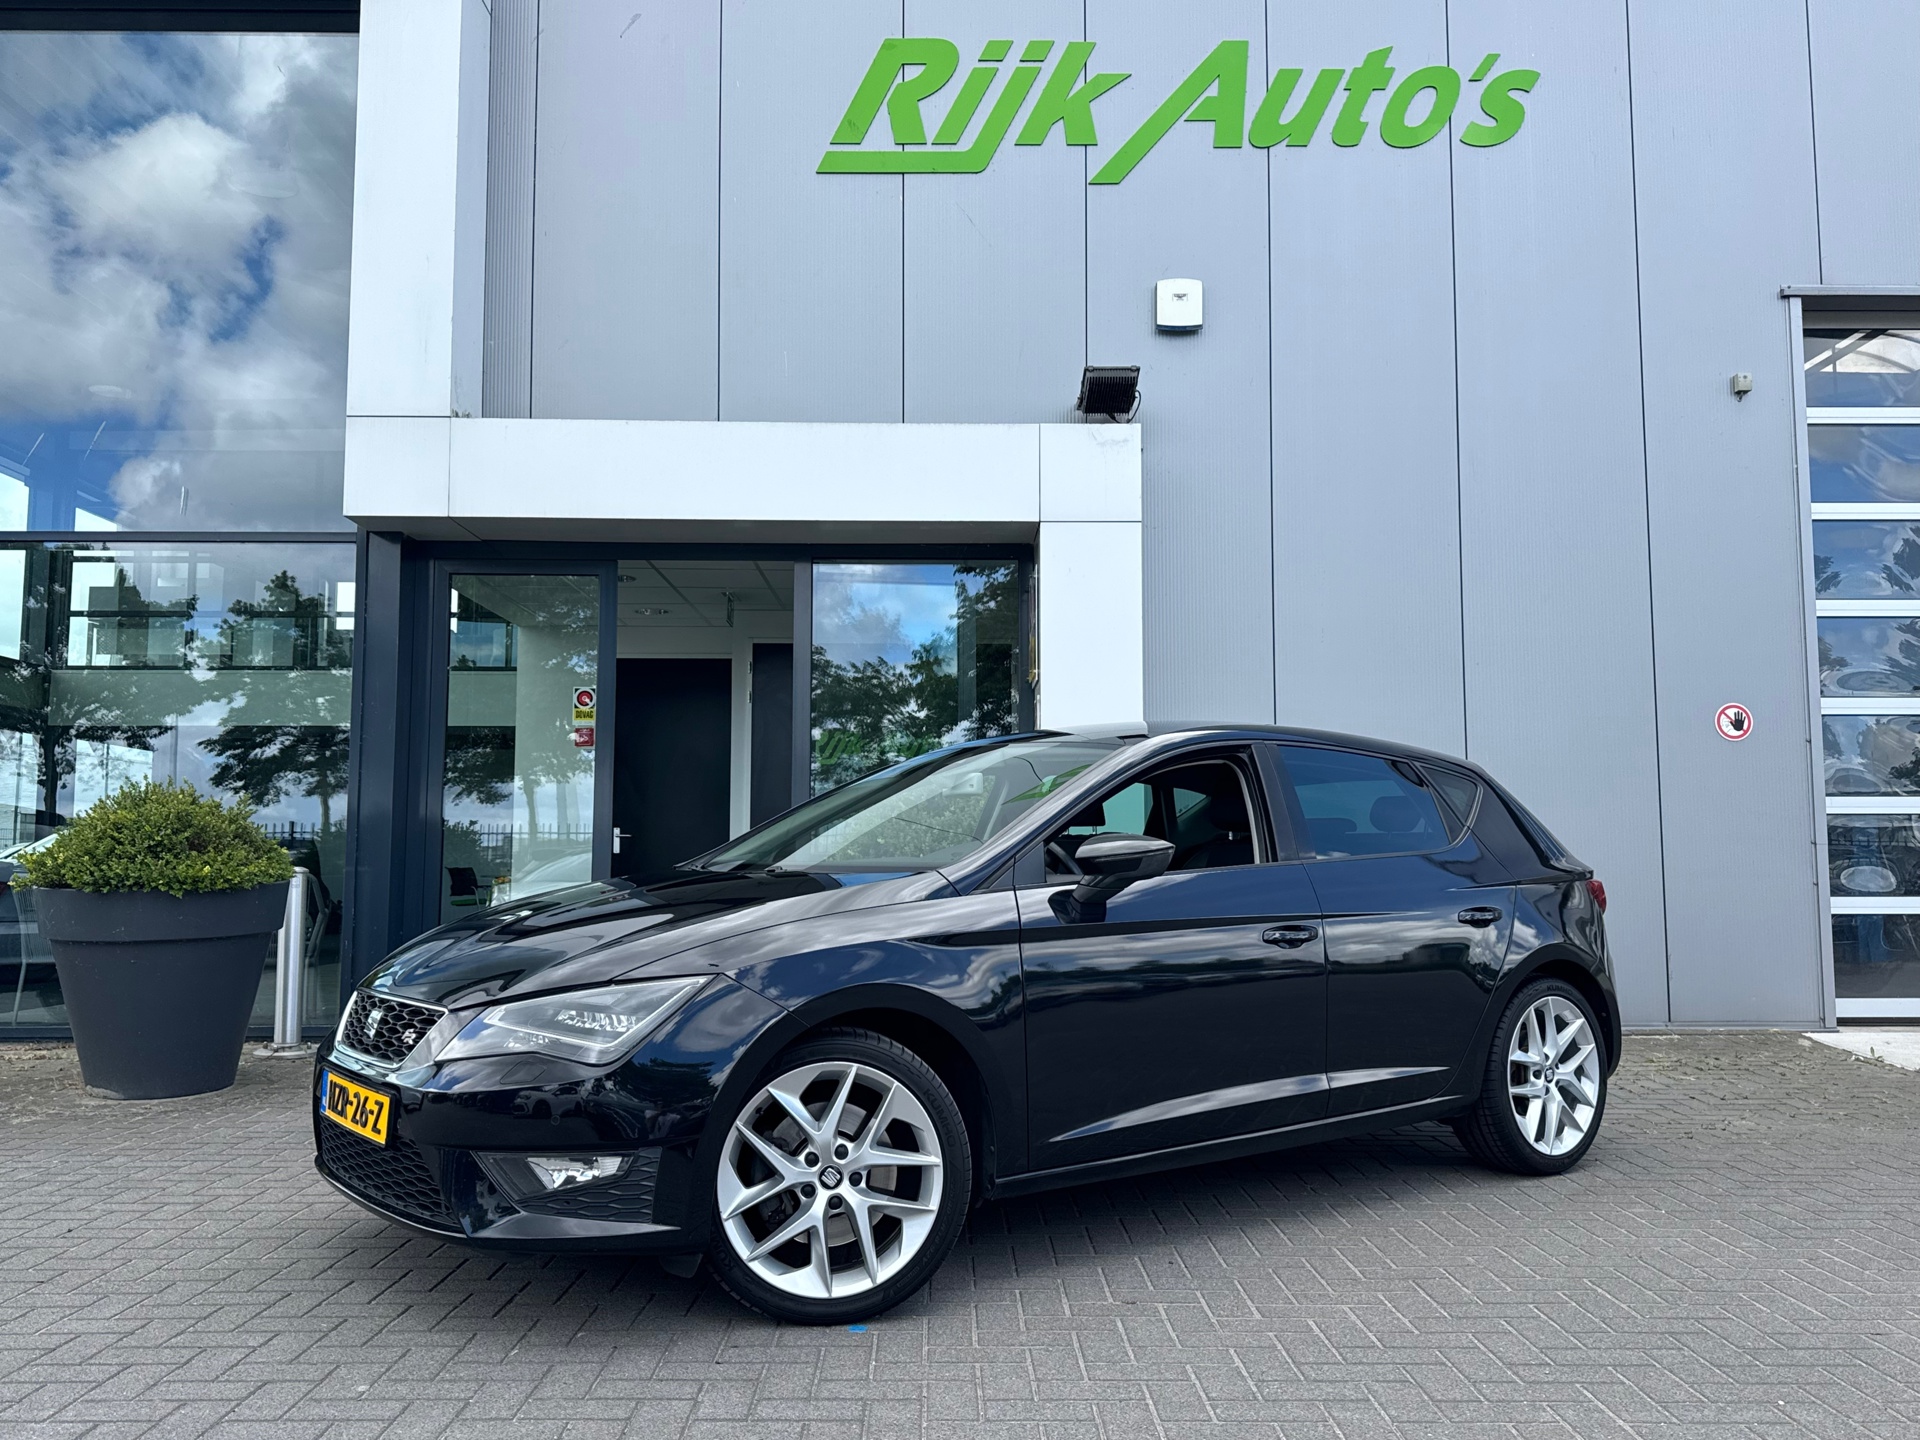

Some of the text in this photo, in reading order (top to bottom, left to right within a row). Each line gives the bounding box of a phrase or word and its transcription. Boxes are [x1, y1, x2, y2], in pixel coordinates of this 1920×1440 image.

[816, 37, 1541, 185] Rijk Auto's
[327, 1079, 385, 1135] HZR-26-Z
[921, 1087, 958, 1148] KUMHO
